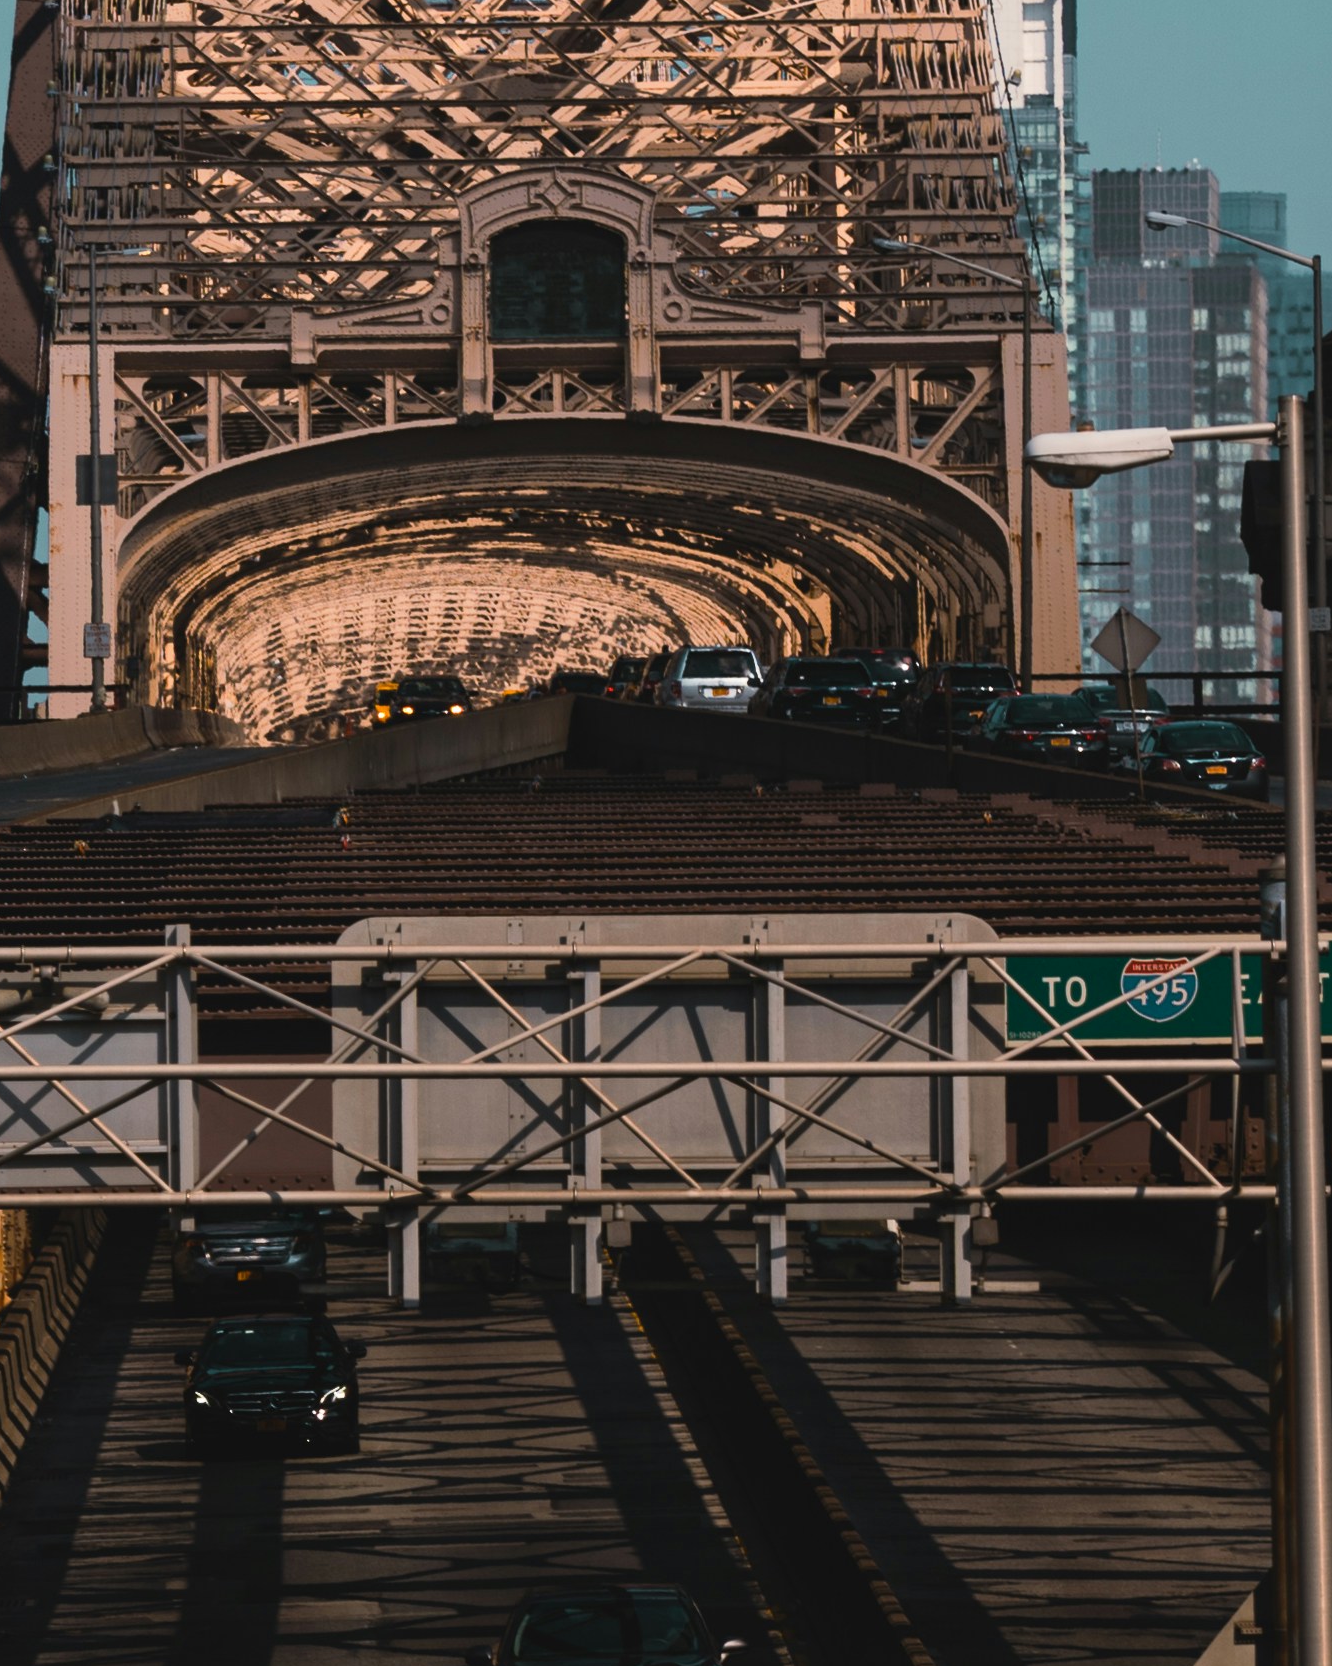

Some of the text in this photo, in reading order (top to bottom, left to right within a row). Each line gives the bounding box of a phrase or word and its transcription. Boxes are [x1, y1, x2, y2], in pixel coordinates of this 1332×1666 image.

[1132, 963, 1185, 972] INTERSTAT
[1041, 975, 1088, 1008] TO
[1134, 978, 1189, 1008] 495
